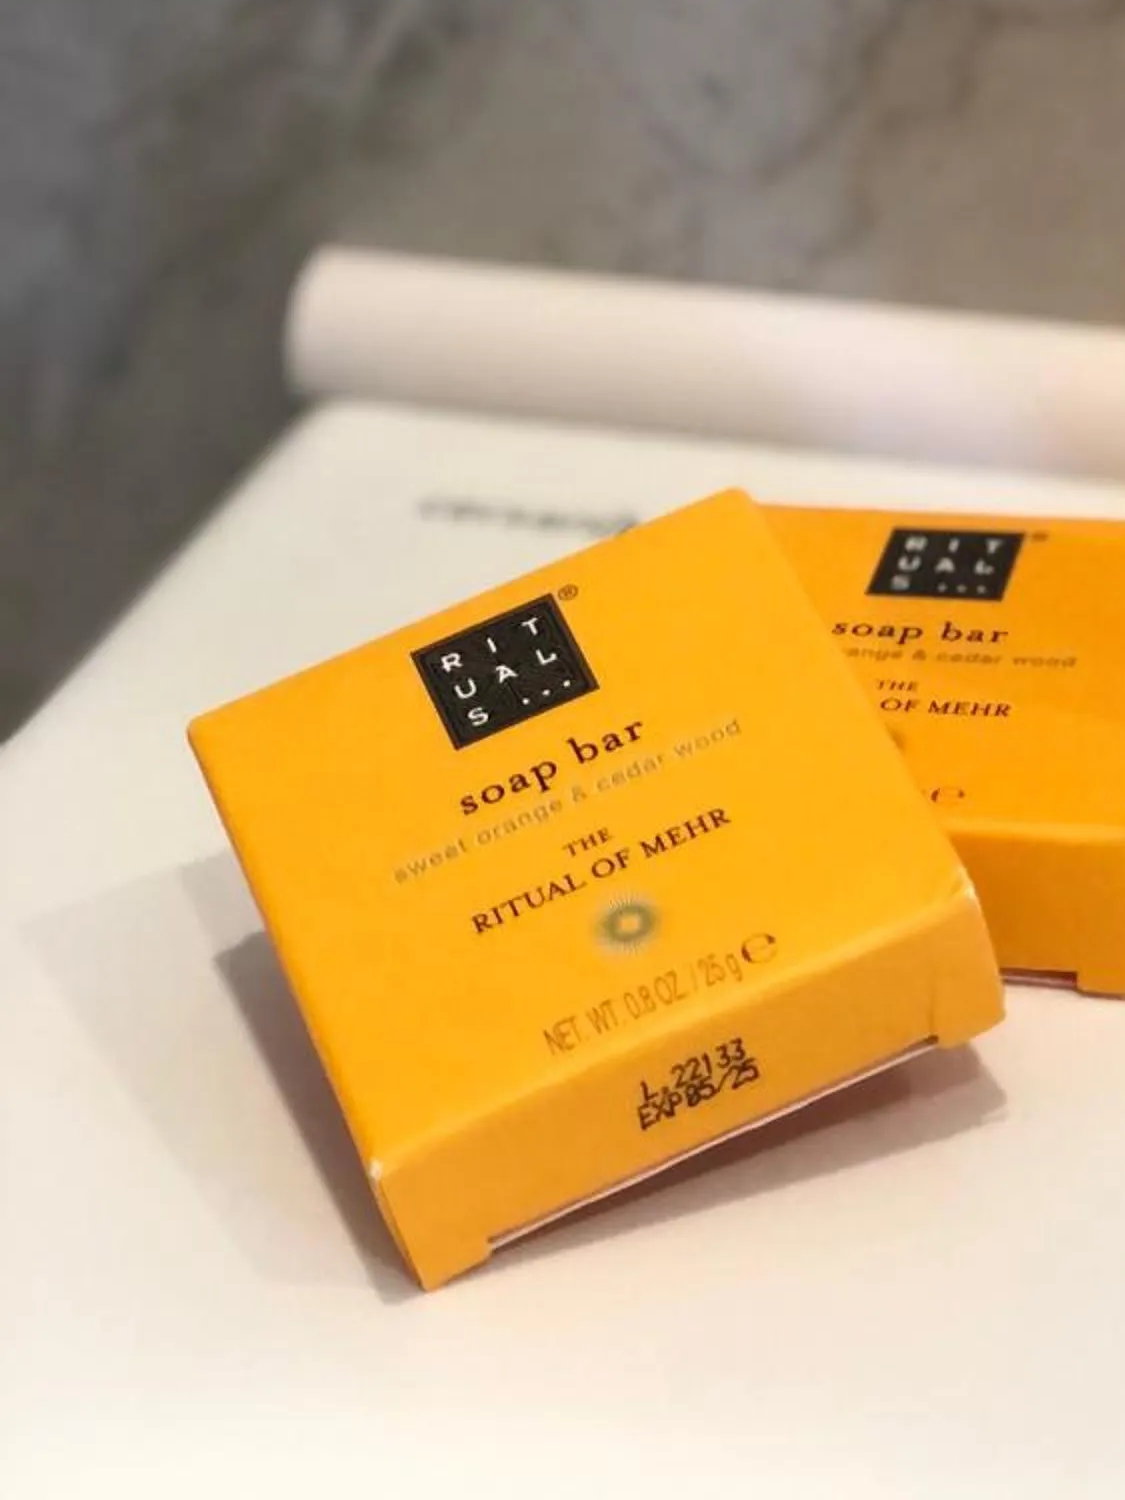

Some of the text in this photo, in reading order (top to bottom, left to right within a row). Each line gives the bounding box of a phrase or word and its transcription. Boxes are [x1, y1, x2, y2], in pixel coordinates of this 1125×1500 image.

[831, 620, 1009, 645] soap bar
[936, 650, 1002, 665] cedar
[1012, 655, 1078, 669] wood
[877, 678, 919, 692] THE
[880, 697, 1012, 718] OF MEHR
[459, 720, 644, 816] soap bar
[394, 718, 743, 884] sweet orange & cedar wood
[562, 827, 615, 858] THE
[471, 807, 732, 935] RITUAL OF MEHR
[669, 1037, 747, 1089] 22133
